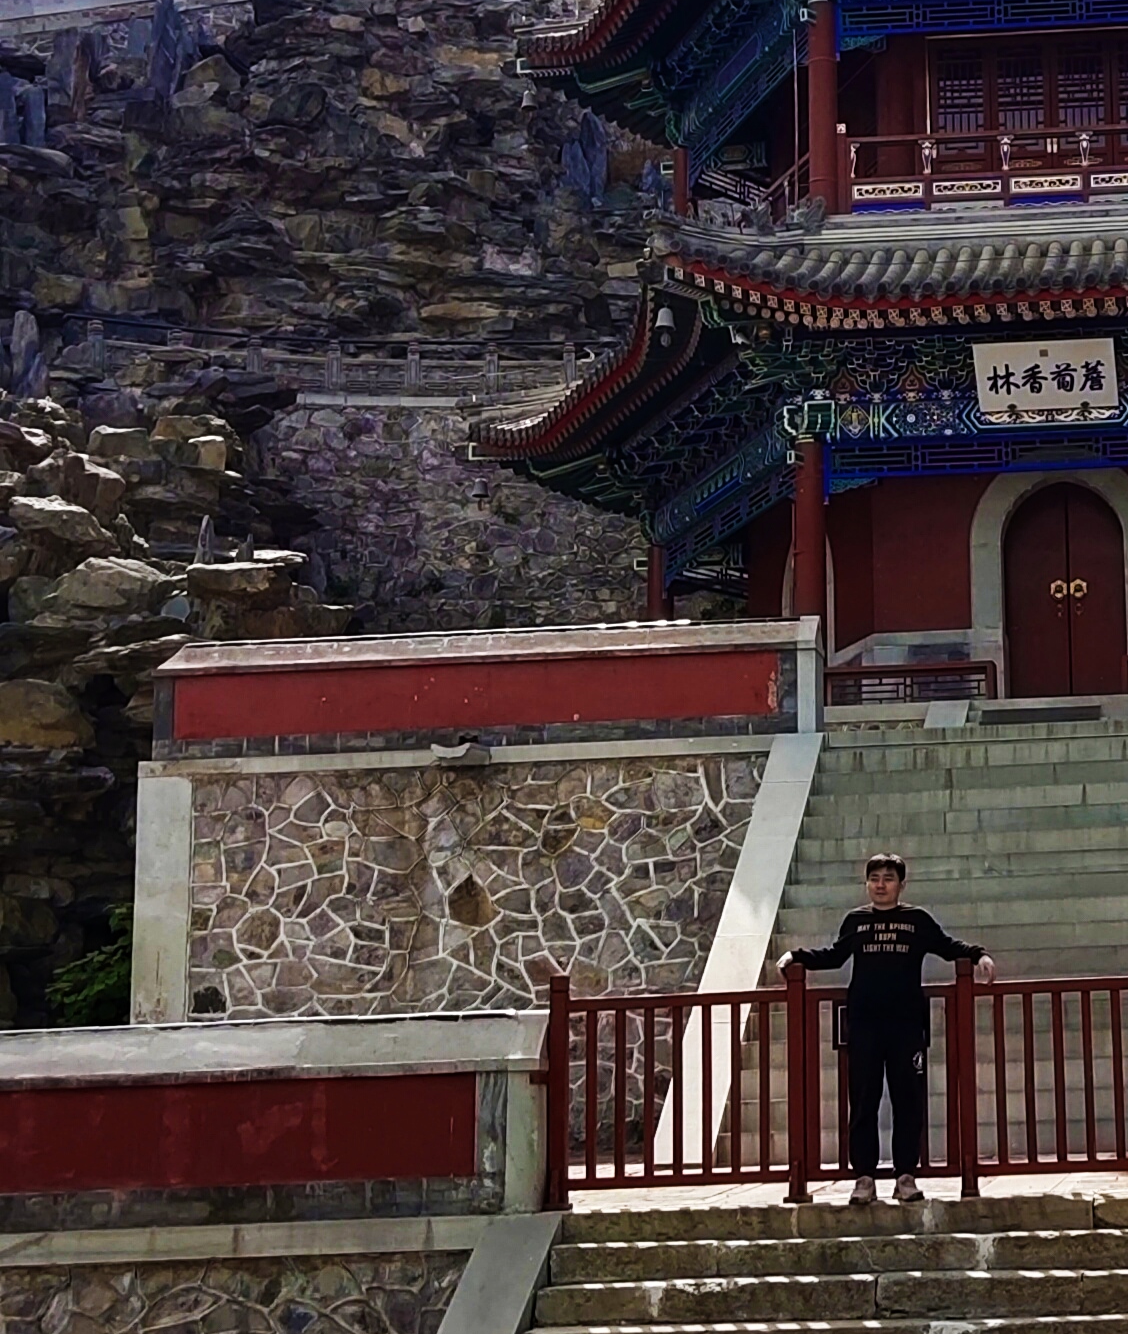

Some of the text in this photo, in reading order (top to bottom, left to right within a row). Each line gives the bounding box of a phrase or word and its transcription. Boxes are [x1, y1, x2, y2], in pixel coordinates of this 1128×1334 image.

[857, 924, 870, 932] MAY
[863, 944, 881, 952] LIGHT
[896, 944, 909, 953] WAY
